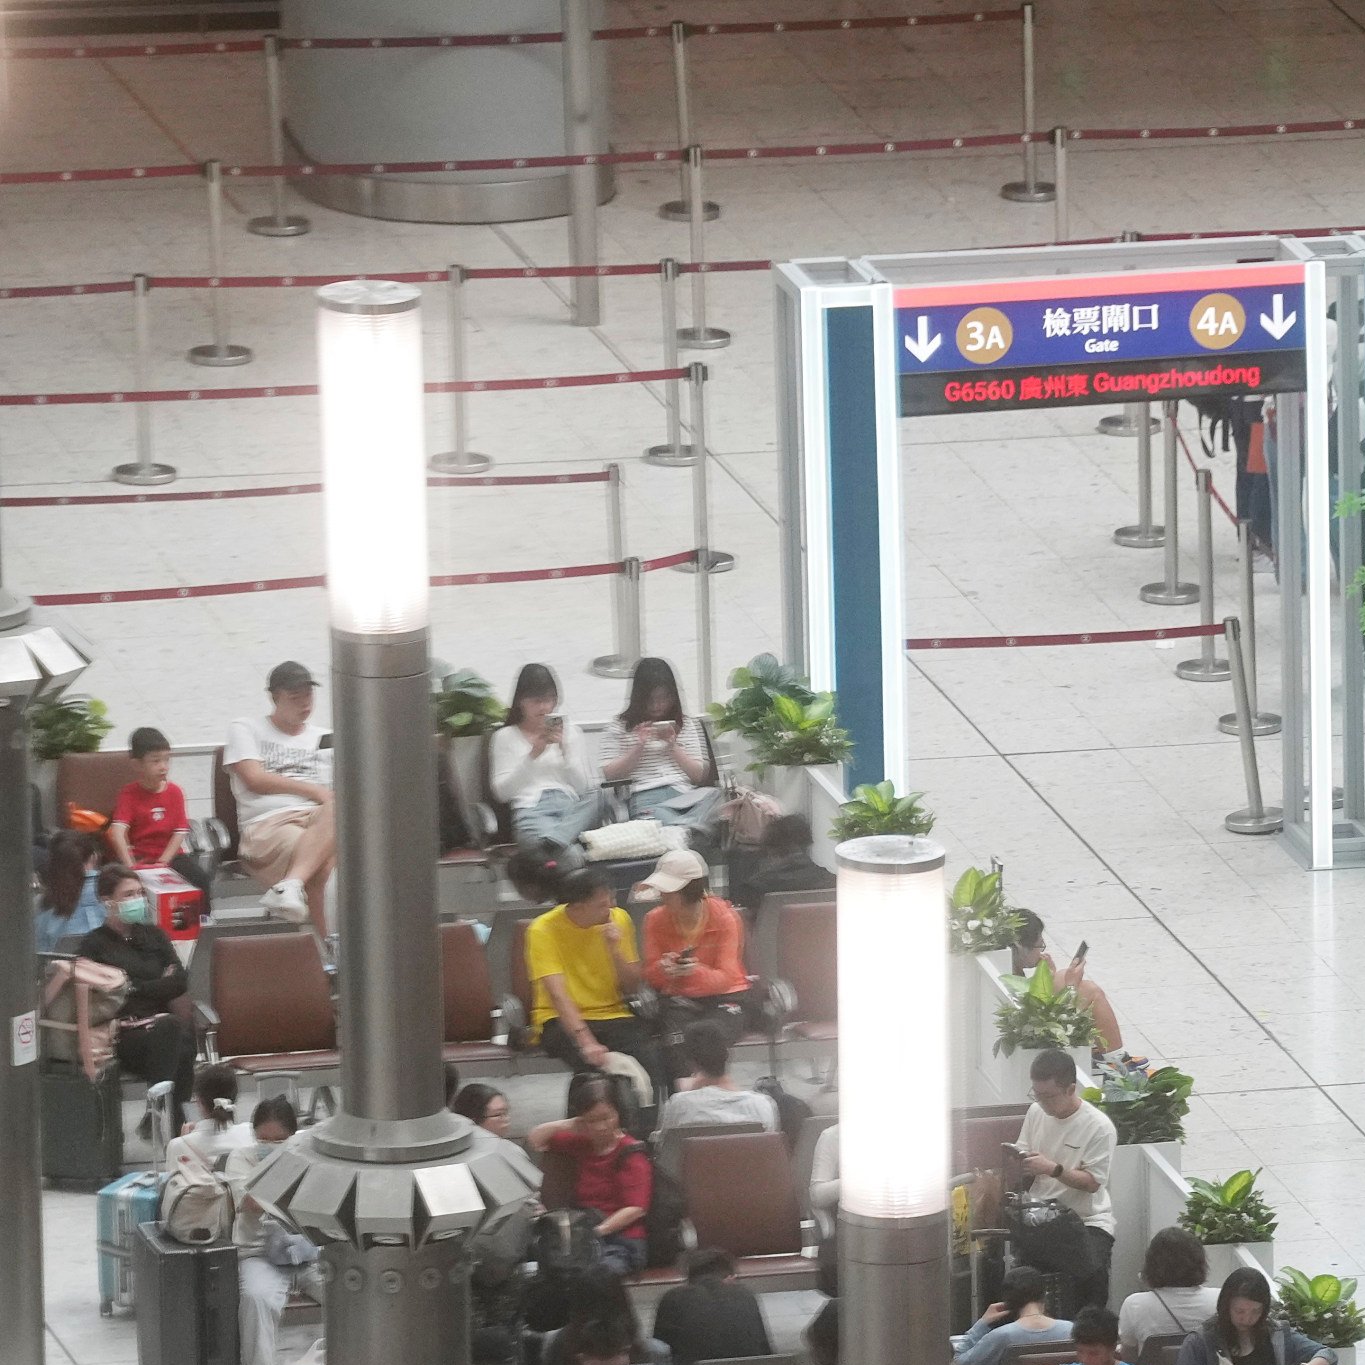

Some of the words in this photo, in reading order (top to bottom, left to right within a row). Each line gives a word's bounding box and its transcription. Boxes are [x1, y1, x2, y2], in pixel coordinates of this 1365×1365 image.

[1042, 303, 1160, 338] 檢票閘口
[1196, 306, 1239, 337] 4A
[966, 322, 1006, 353] 3A
[1084, 338, 1120, 354] Gate
[944, 379, 1016, 403] G6560
[1018, 373, 1090, 402] 廣州東
[1092, 364, 1261, 394] Guangzhoudong
